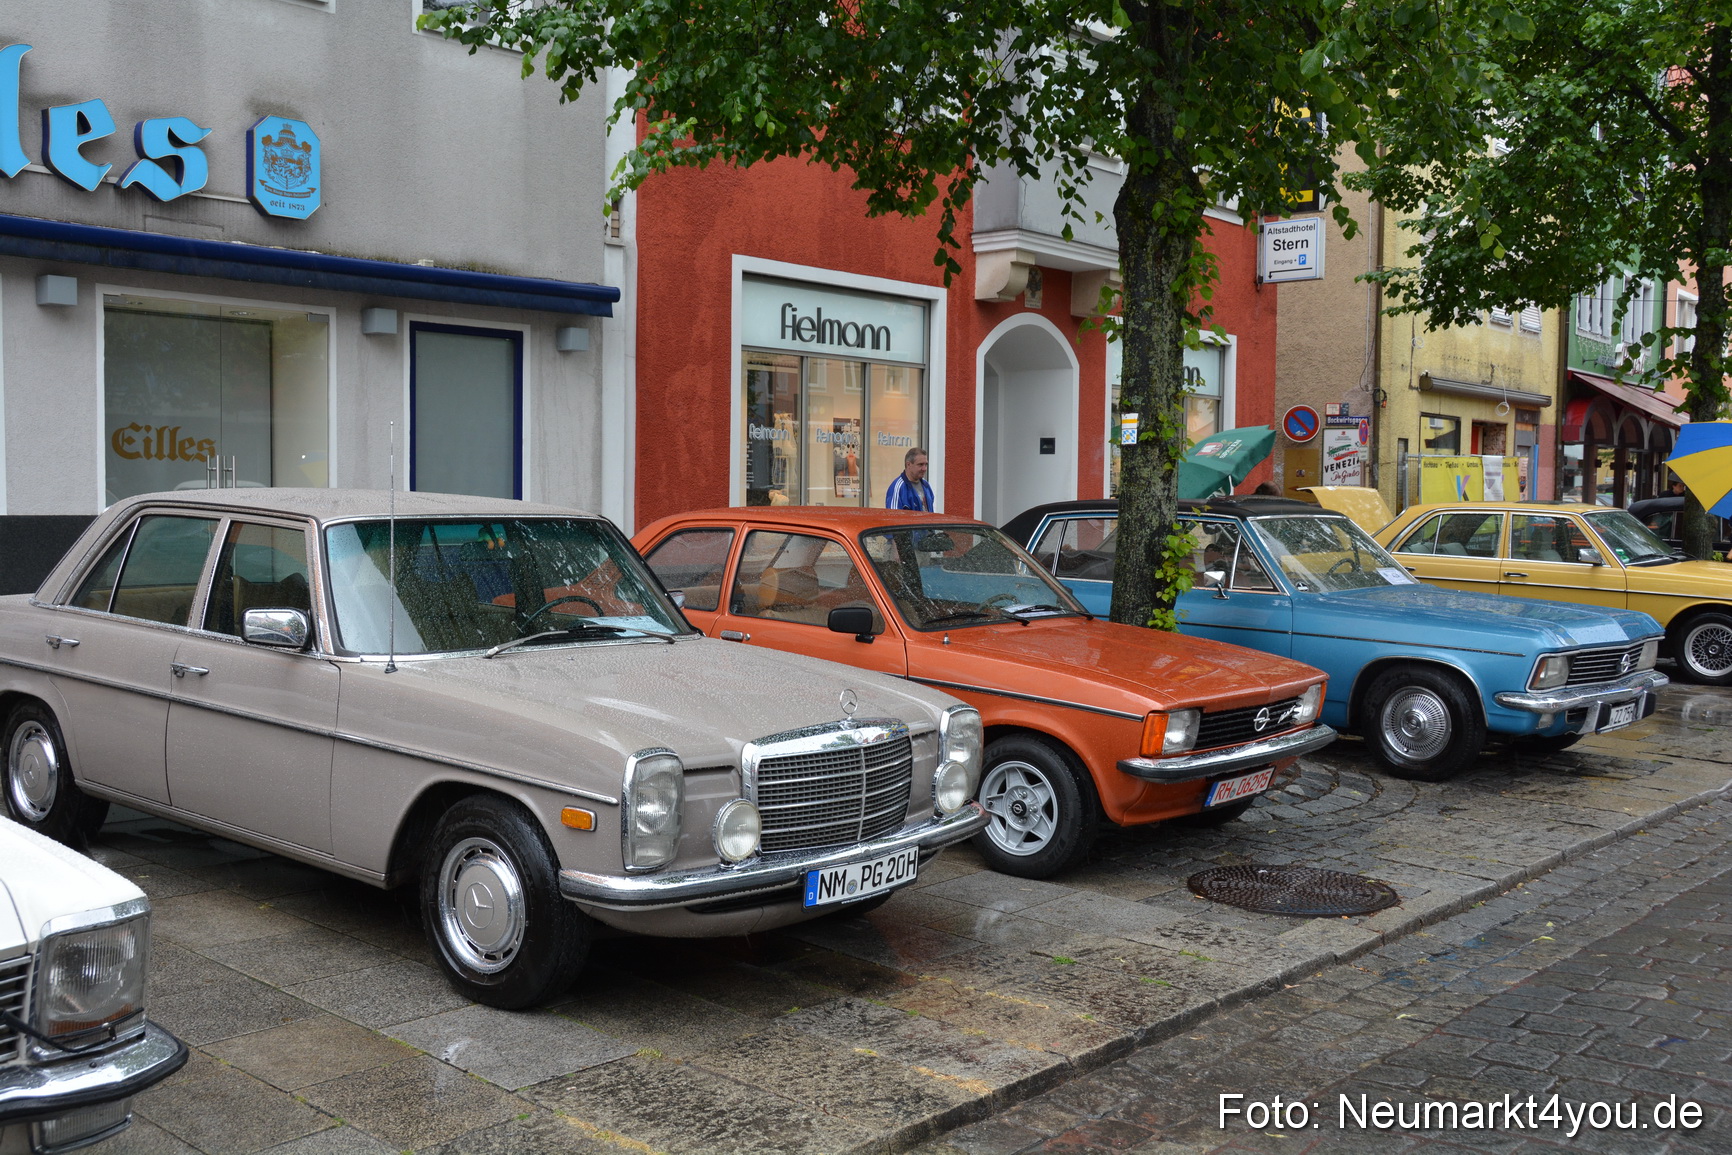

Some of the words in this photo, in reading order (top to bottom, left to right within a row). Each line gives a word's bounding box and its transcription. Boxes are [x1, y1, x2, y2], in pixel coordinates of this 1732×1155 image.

[269, 199, 285, 208] seit
[288, 203, 305, 211] 1873
[1267, 223, 1316, 235] Altstadthotel
[1273, 239, 1309, 252] Stern
[781, 303, 891, 352] fielmann
[111, 421, 217, 463] Eilles
[1215, 781, 1234, 801] RH
[1236, 771, 1271, 796] 06295
[818, 869, 847, 900] NM
[860, 861, 883, 891] PG
[885, 850, 917, 884] 20H
